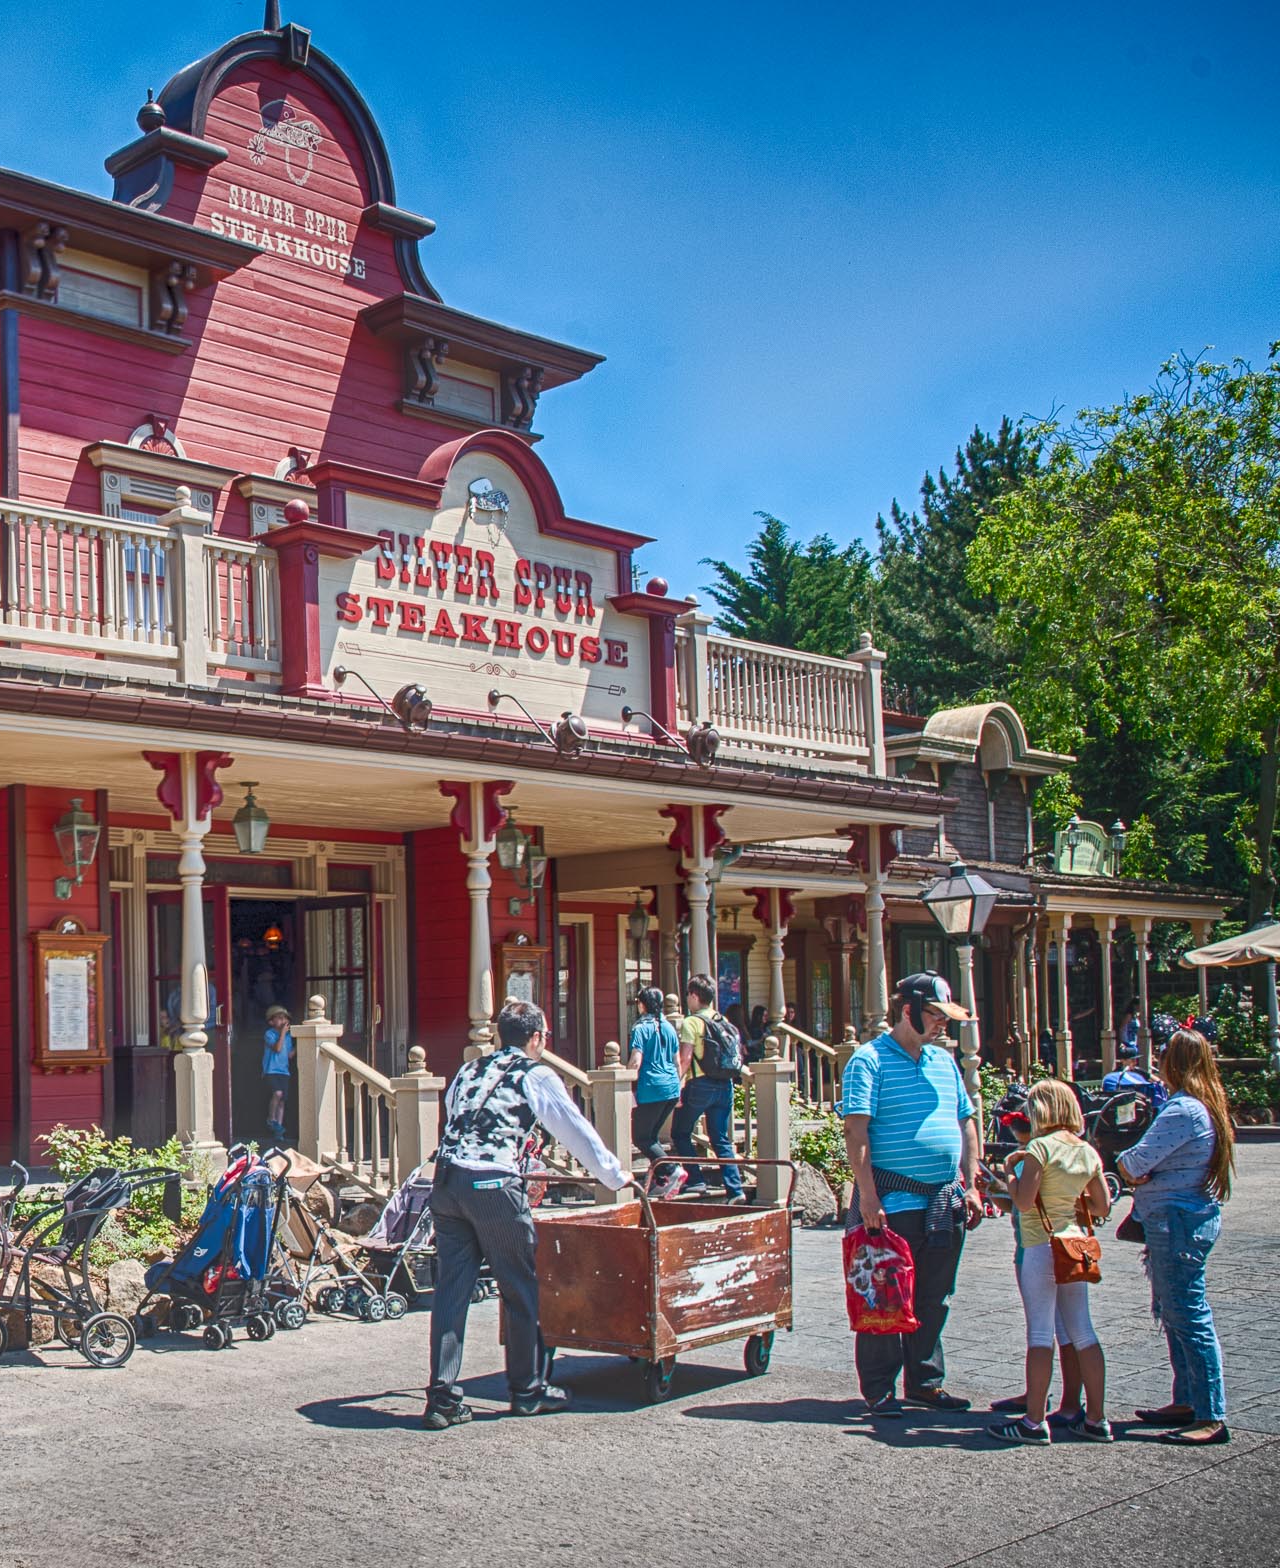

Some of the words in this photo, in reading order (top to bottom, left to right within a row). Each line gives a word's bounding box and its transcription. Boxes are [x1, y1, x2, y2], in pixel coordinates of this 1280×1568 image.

[210, 212, 366, 280] STEAKHOUSE
[228, 184, 296, 229] SILVER
[304, 208, 349, 246] SPUR
[376, 530, 500, 600] SILVER
[514, 558, 596, 618] SPUR
[336, 592, 629, 669] STEAKHOUSE
